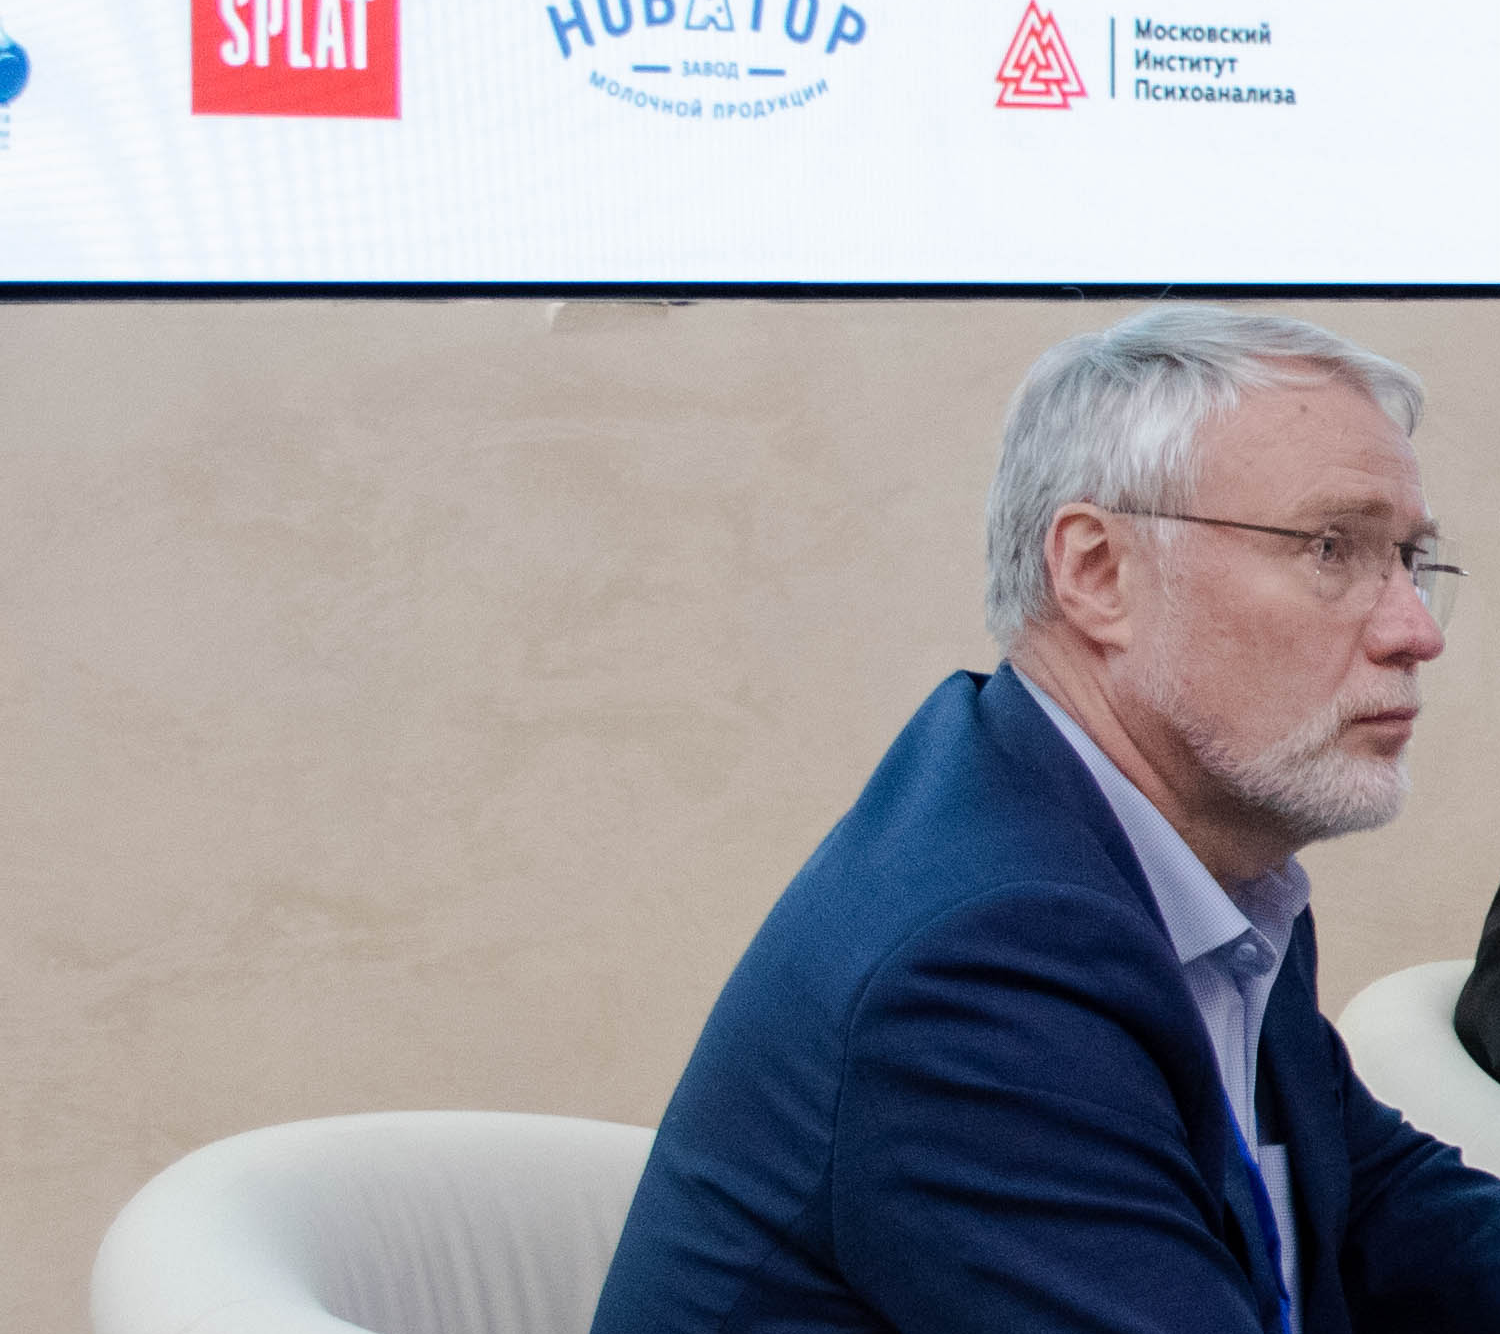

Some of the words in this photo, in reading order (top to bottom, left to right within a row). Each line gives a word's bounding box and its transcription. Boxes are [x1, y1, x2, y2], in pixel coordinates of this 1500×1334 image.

[1133, 15, 1272, 48] Московский
[682, 61, 739, 79] ЗАВОД
[1133, 49, 1238, 78] Институт
[589, 70, 702, 119] МОЛОЧНОЙ
[713, 78, 829, 119] ПРОДУКЦИИ
[1133, 79, 1298, 108] Психоанализа
